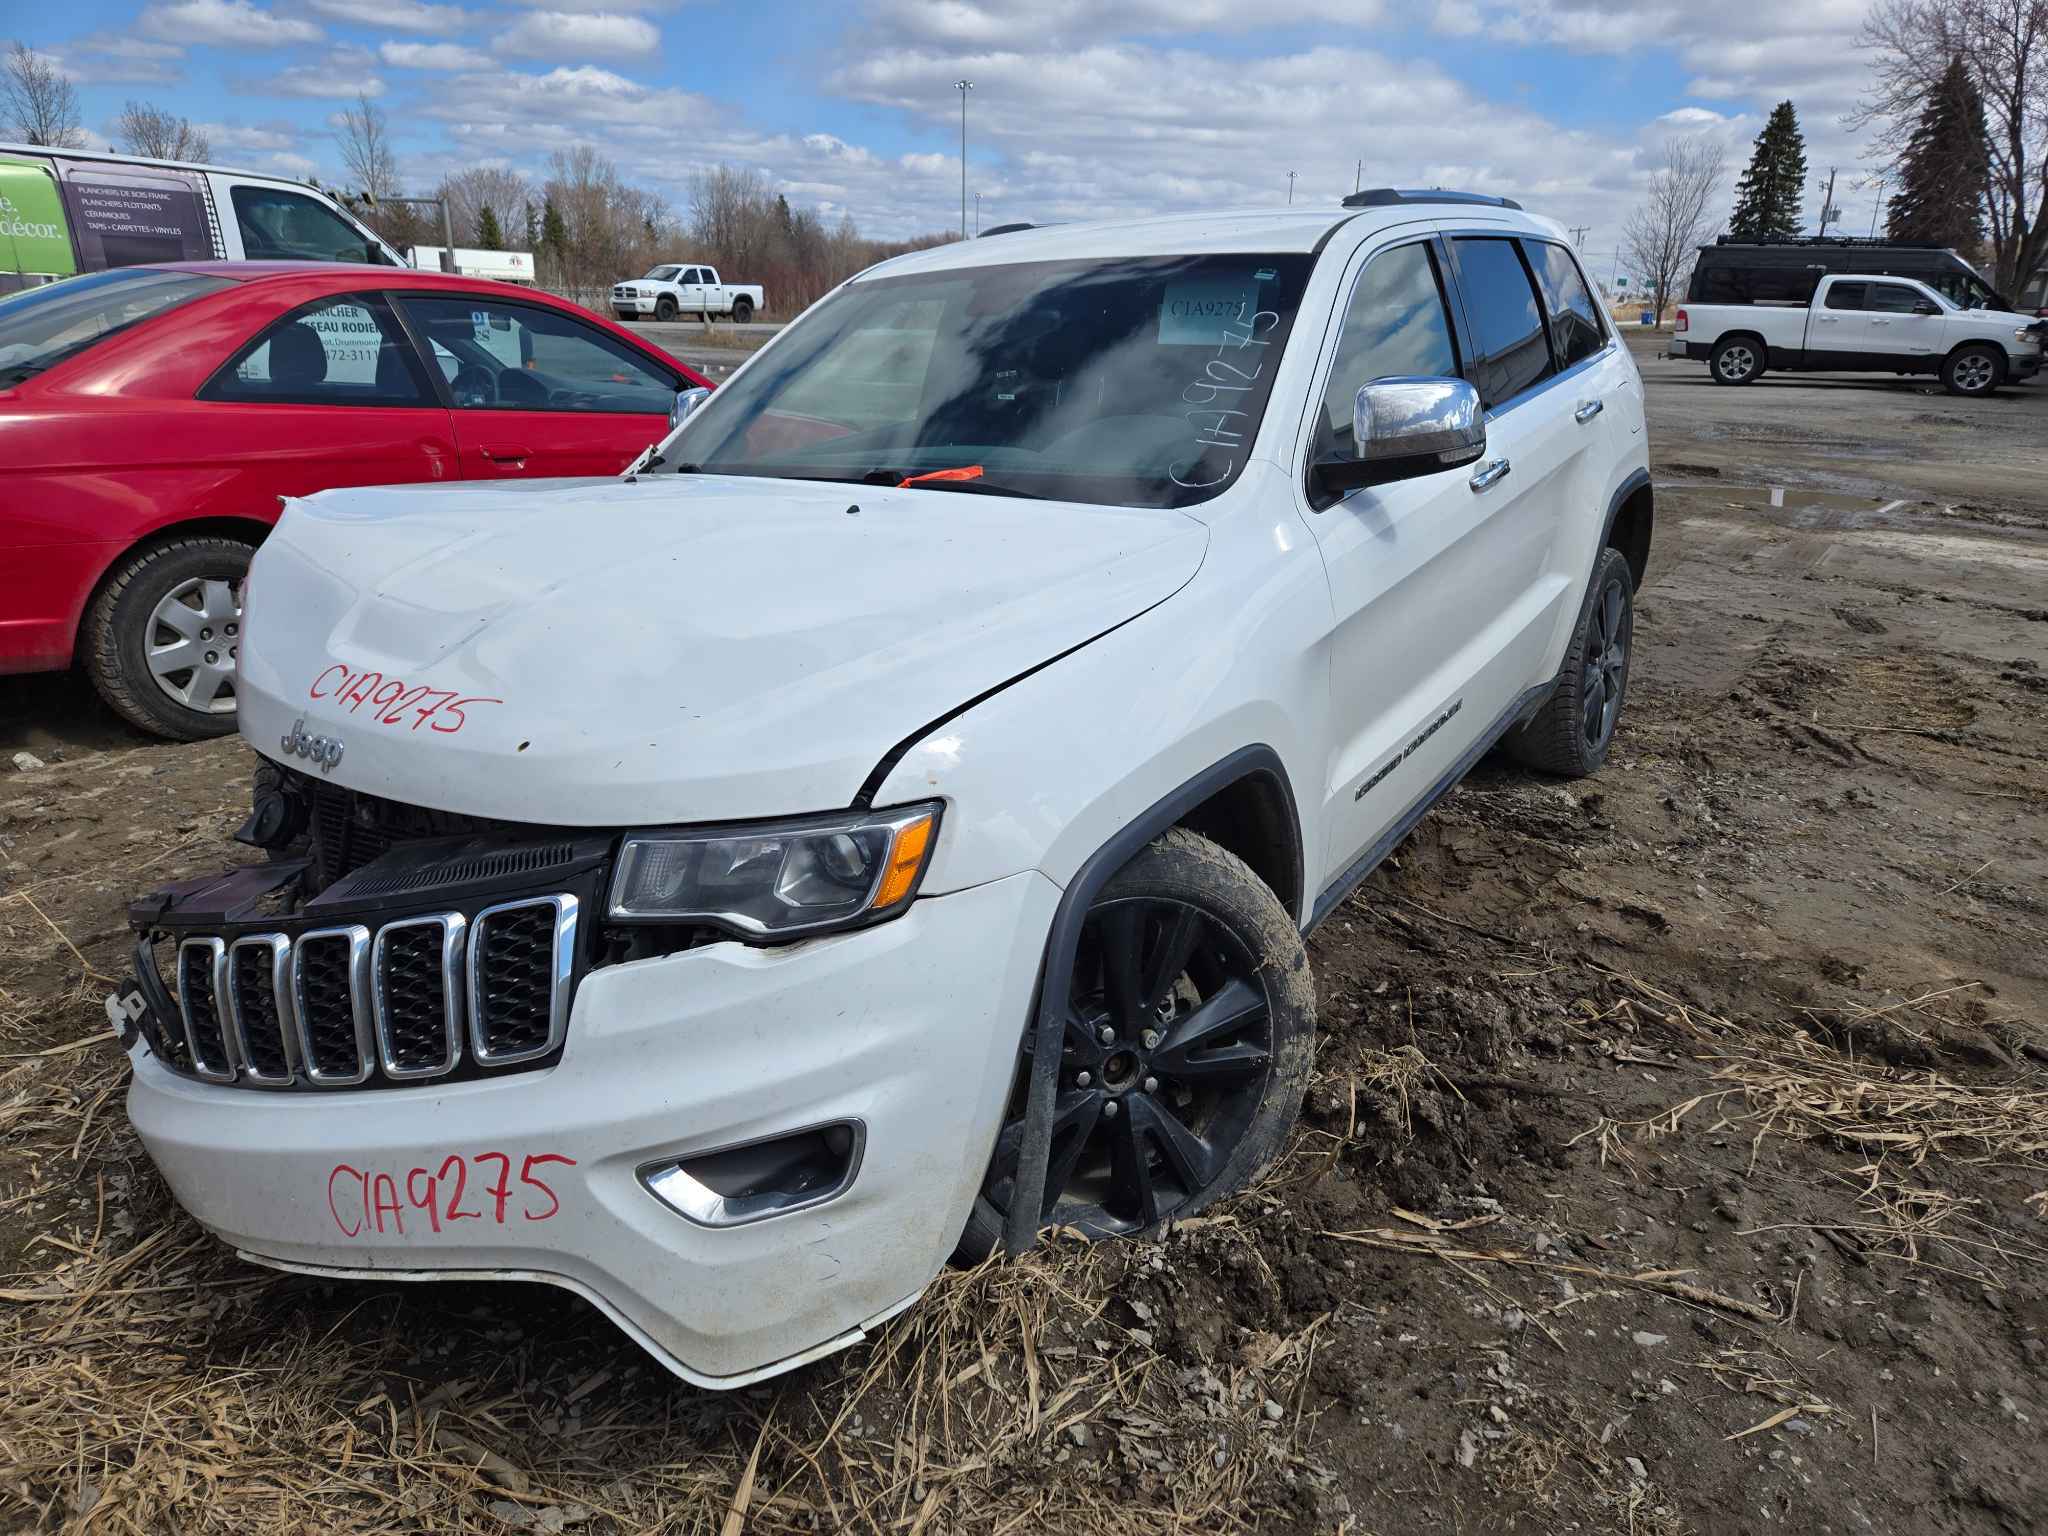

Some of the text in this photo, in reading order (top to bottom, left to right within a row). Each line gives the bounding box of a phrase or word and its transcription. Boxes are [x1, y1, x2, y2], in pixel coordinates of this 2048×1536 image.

[78, 187, 120, 196] PLANCHERS
[132, 191, 148, 199] BOIS
[149, 192, 171, 200] FRANC
[81, 198, 162, 211] PLANCHERS FLOTTANTS
[87, 222, 107, 231] TAPIS
[153, 225, 182, 235] VINYLES
[281, 718, 345, 775] Jeep
